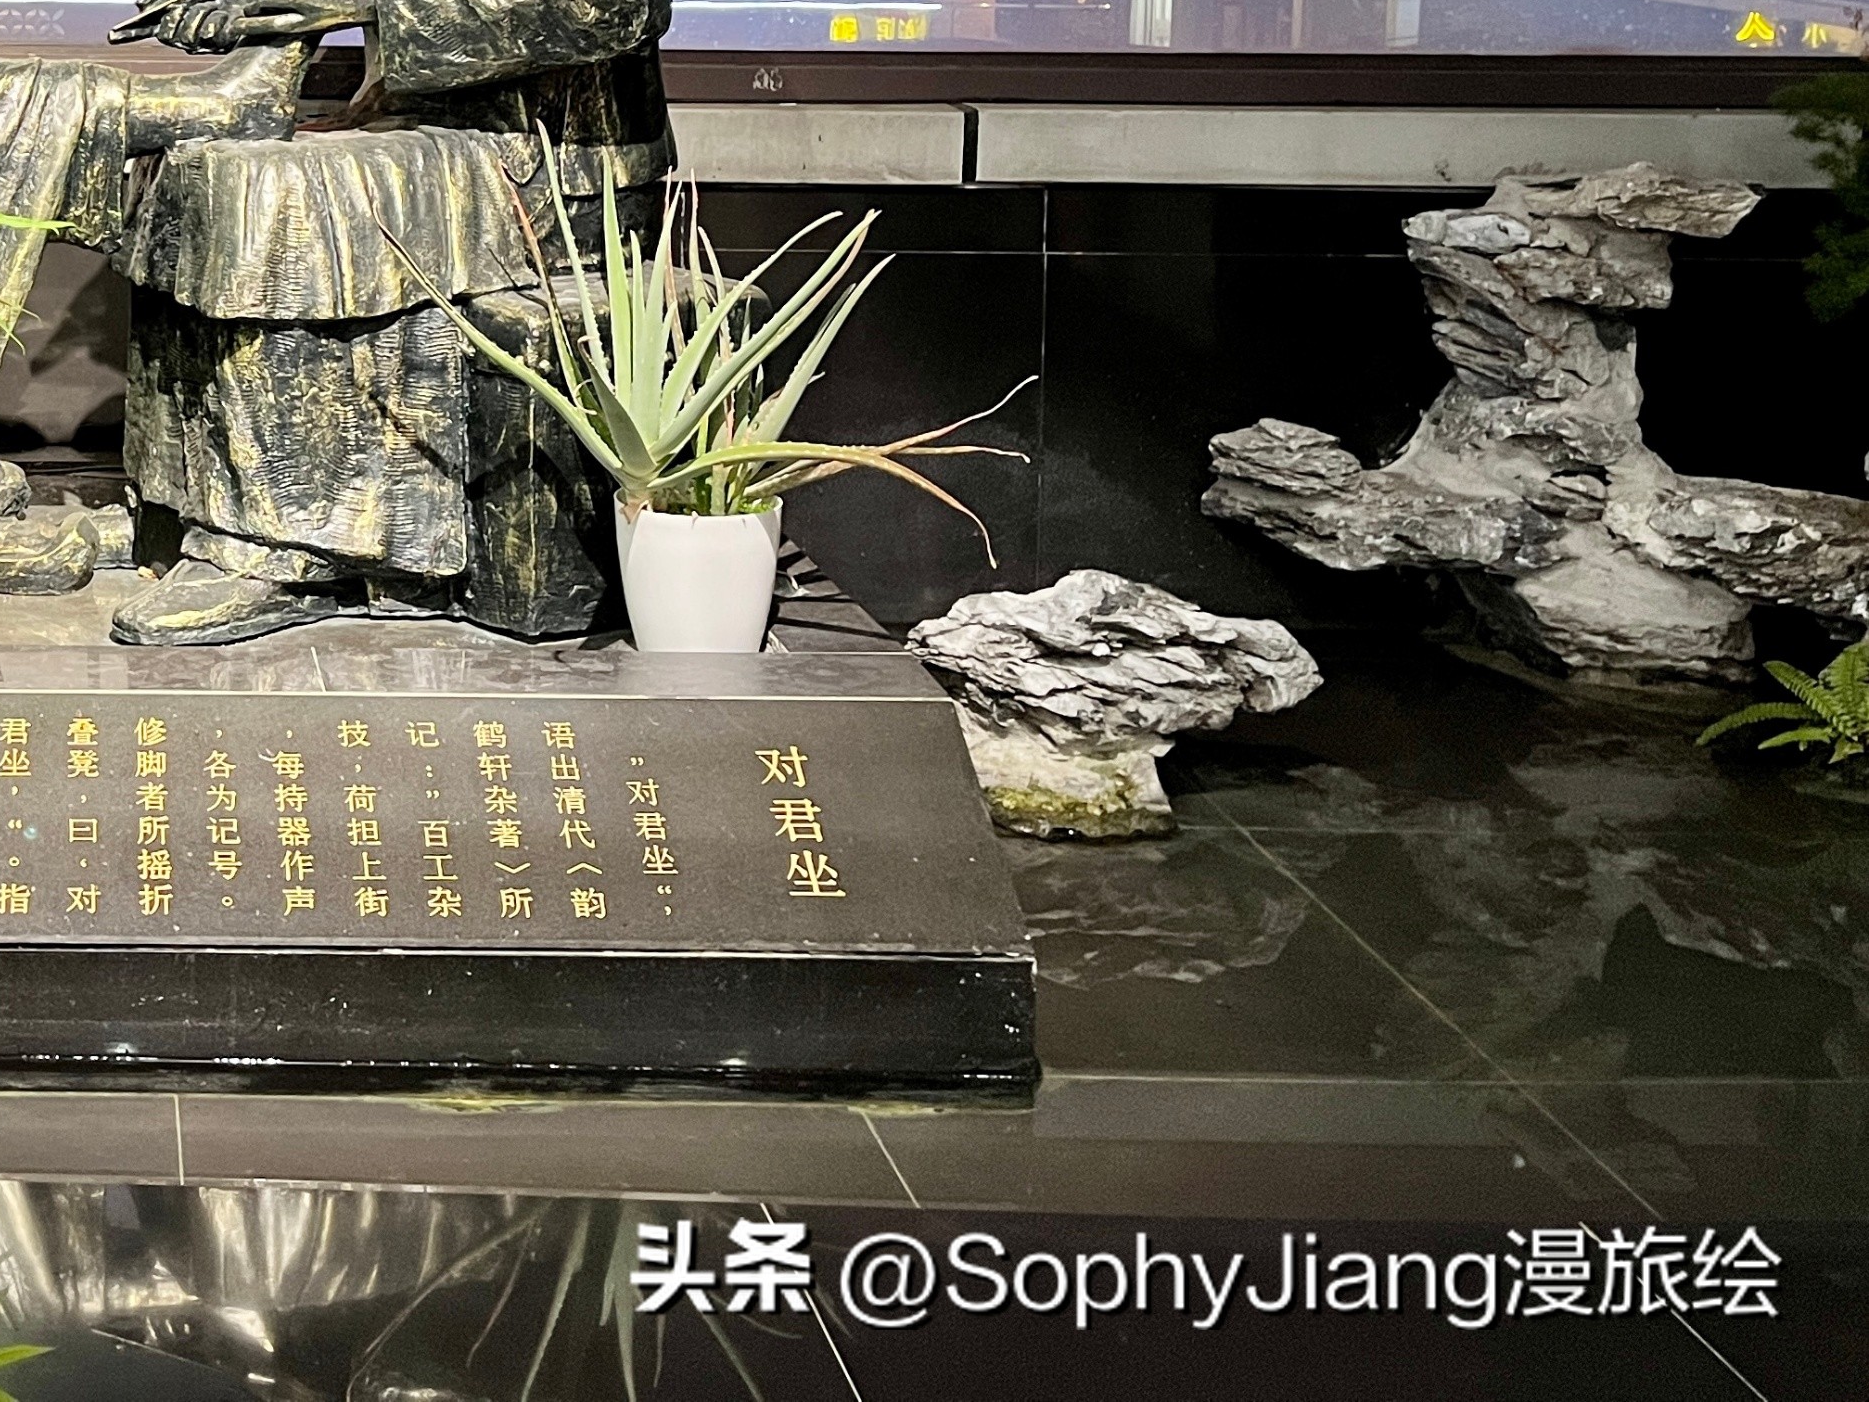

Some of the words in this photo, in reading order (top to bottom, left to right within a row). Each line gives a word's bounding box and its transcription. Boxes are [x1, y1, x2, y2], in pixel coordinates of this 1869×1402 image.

[134, 718, 174, 916] 修脚者所摇折
[755, 746, 846, 898] 对君坐
